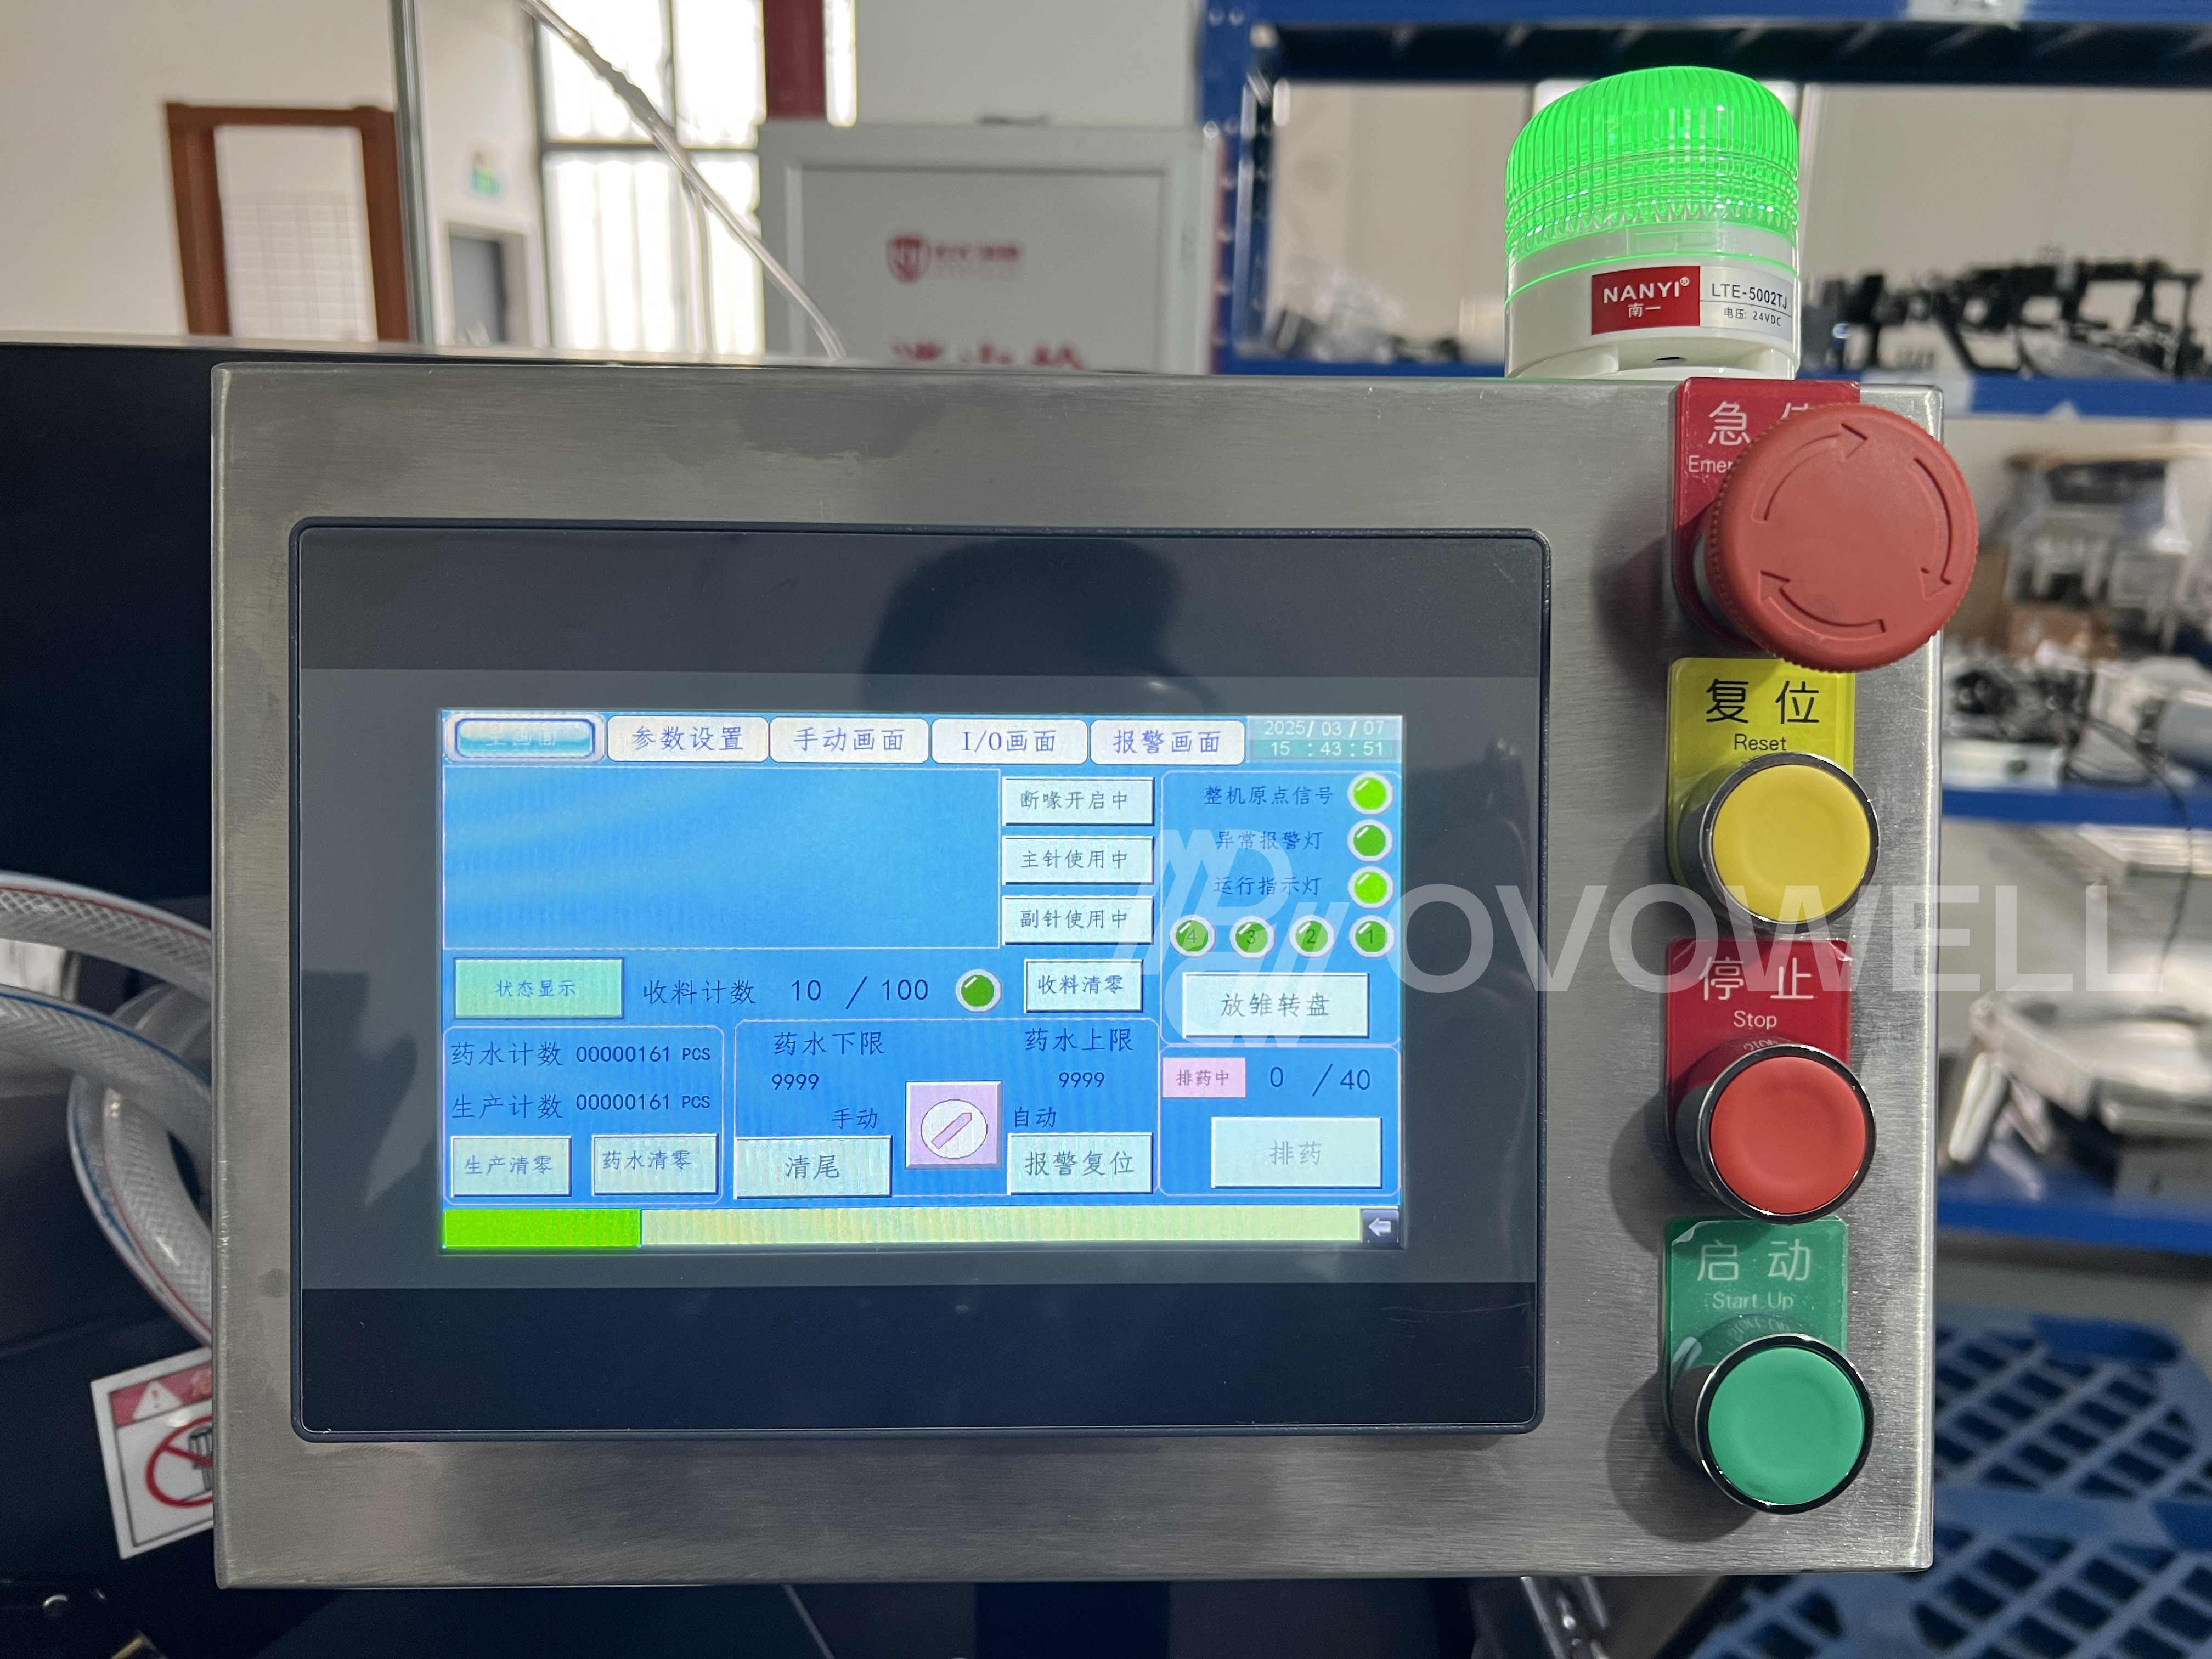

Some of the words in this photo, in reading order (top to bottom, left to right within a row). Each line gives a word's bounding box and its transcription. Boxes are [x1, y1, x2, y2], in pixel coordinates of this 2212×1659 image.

[1711, 283, 1788, 309] LTE-5002TJ
[1627, 303, 1661, 318] 南一
[1752, 311, 1781, 326] 24VDC
[1706, 679, 1820, 724] 复位
[632, 725, 744, 751] 参数设置
[794, 727, 905, 752] 手动画面
[961, 730, 1056, 753] I/O画面
[1113, 730, 1221, 754] 报警画面
[1734, 733, 1787, 751] Reset
[1204, 786, 1334, 805] 整机原点信号
[1216, 831, 1323, 850] 异常报警灯
[1020, 850, 1128, 871] 主针使用中
[1214, 876, 1322, 895] 运行指示灯
[1020, 910, 1128, 930] 副针使用中
[1186, 929, 1197, 943] 4
[1246, 930, 1256, 944] 3
[1306, 929, 1316, 944] 2
[1367, 929, 1374, 944] 1
[496, 980, 576, 998] 状态显示
[1037, 975, 1124, 995] 收料清零
[1699, 956, 1814, 1001] 停止
[643, 980, 756, 1005] 收料计数
[792, 980, 822, 1001] 10
[882, 979, 928, 1001] 100
[1220, 992, 1330, 1017] 放雏转盘
[1733, 1010, 1778, 1030] Stop
[773, 1031, 885, 1056] 药水下限
[1025, 1028, 1134, 1053] 药水上限
[451, 1042, 564, 1068] 药水计数
[576, 1046, 670, 1063] 00000161
[682, 1047, 711, 1062] PCS
[772, 1074, 820, 1091] 9999
[1058, 1072, 1105, 1088] 9999
[1176, 1069, 1229, 1087] 排药中
[1269, 1066, 1284, 1088] 0
[452, 1094, 564, 1120] 生产计数
[576, 1093, 670, 1111] 00000161
[682, 1095, 711, 1109] PCS
[831, 1108, 878, 1130] 手动
[1013, 1107, 1057, 1129] 自动
[601, 1150, 691, 1170] 药水清零
[1024, 1151, 1134, 1177] 报警复位
[1269, 1140, 1323, 1166] 排药
[464, 1156, 552, 1175] 生产清零
[785, 1155, 839, 1180] 清尾
[1696, 1238, 1812, 1282] 启动
[1712, 1291, 1757, 1310] Start
[1767, 1291, 1795, 1311] Up
